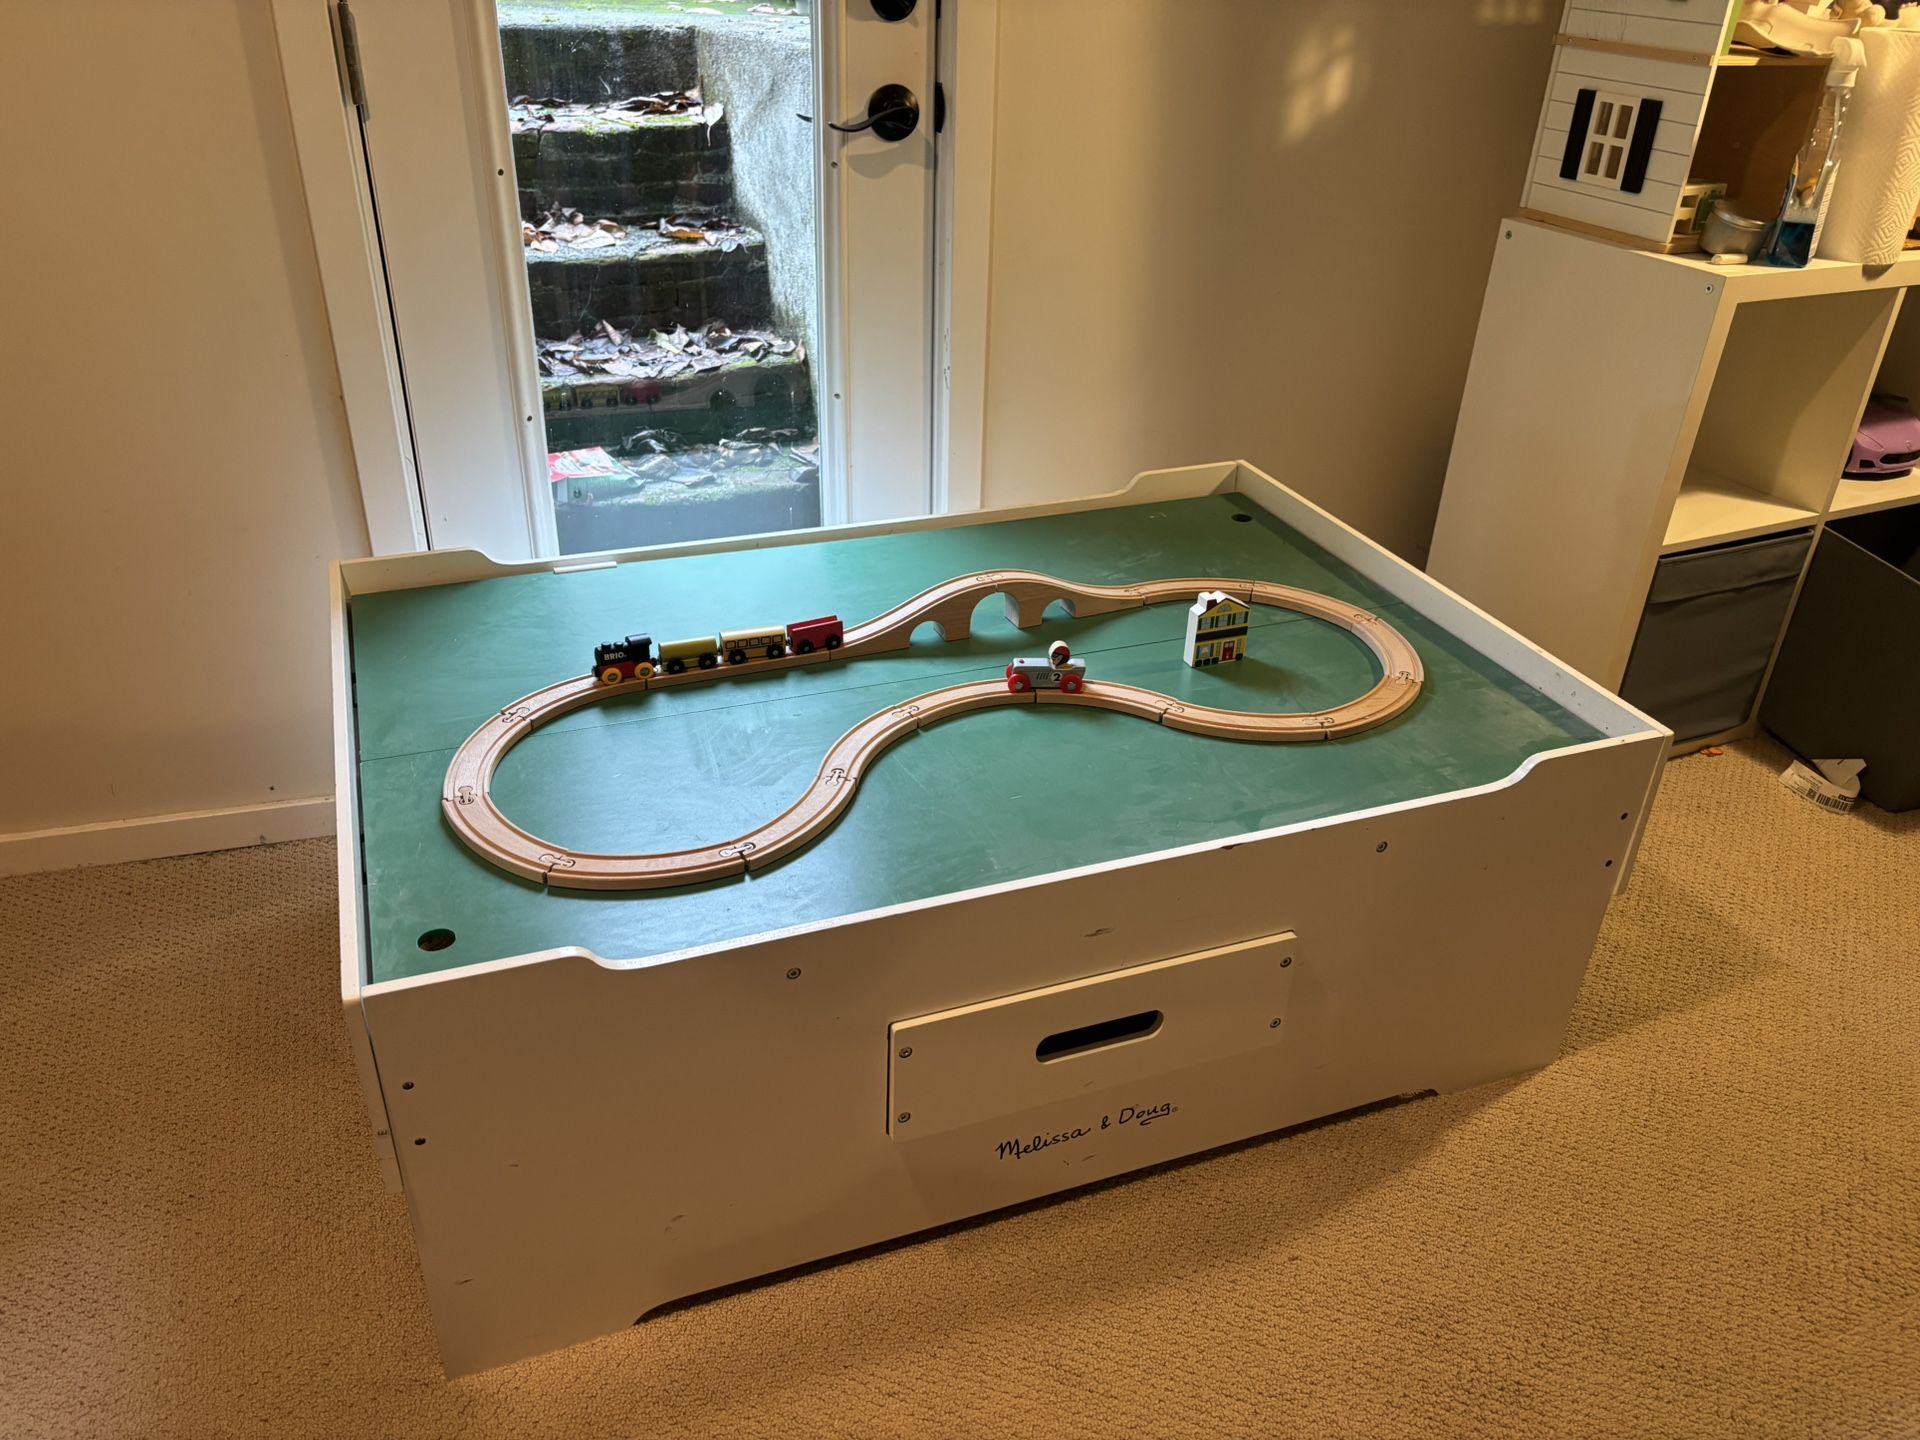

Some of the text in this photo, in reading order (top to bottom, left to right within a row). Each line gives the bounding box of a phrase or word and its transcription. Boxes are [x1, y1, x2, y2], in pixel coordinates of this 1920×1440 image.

[604, 652, 625, 661] BRIO
[1053, 672, 1061, 682] 2
[995, 1102, 1171, 1160] Melissa & Doug
